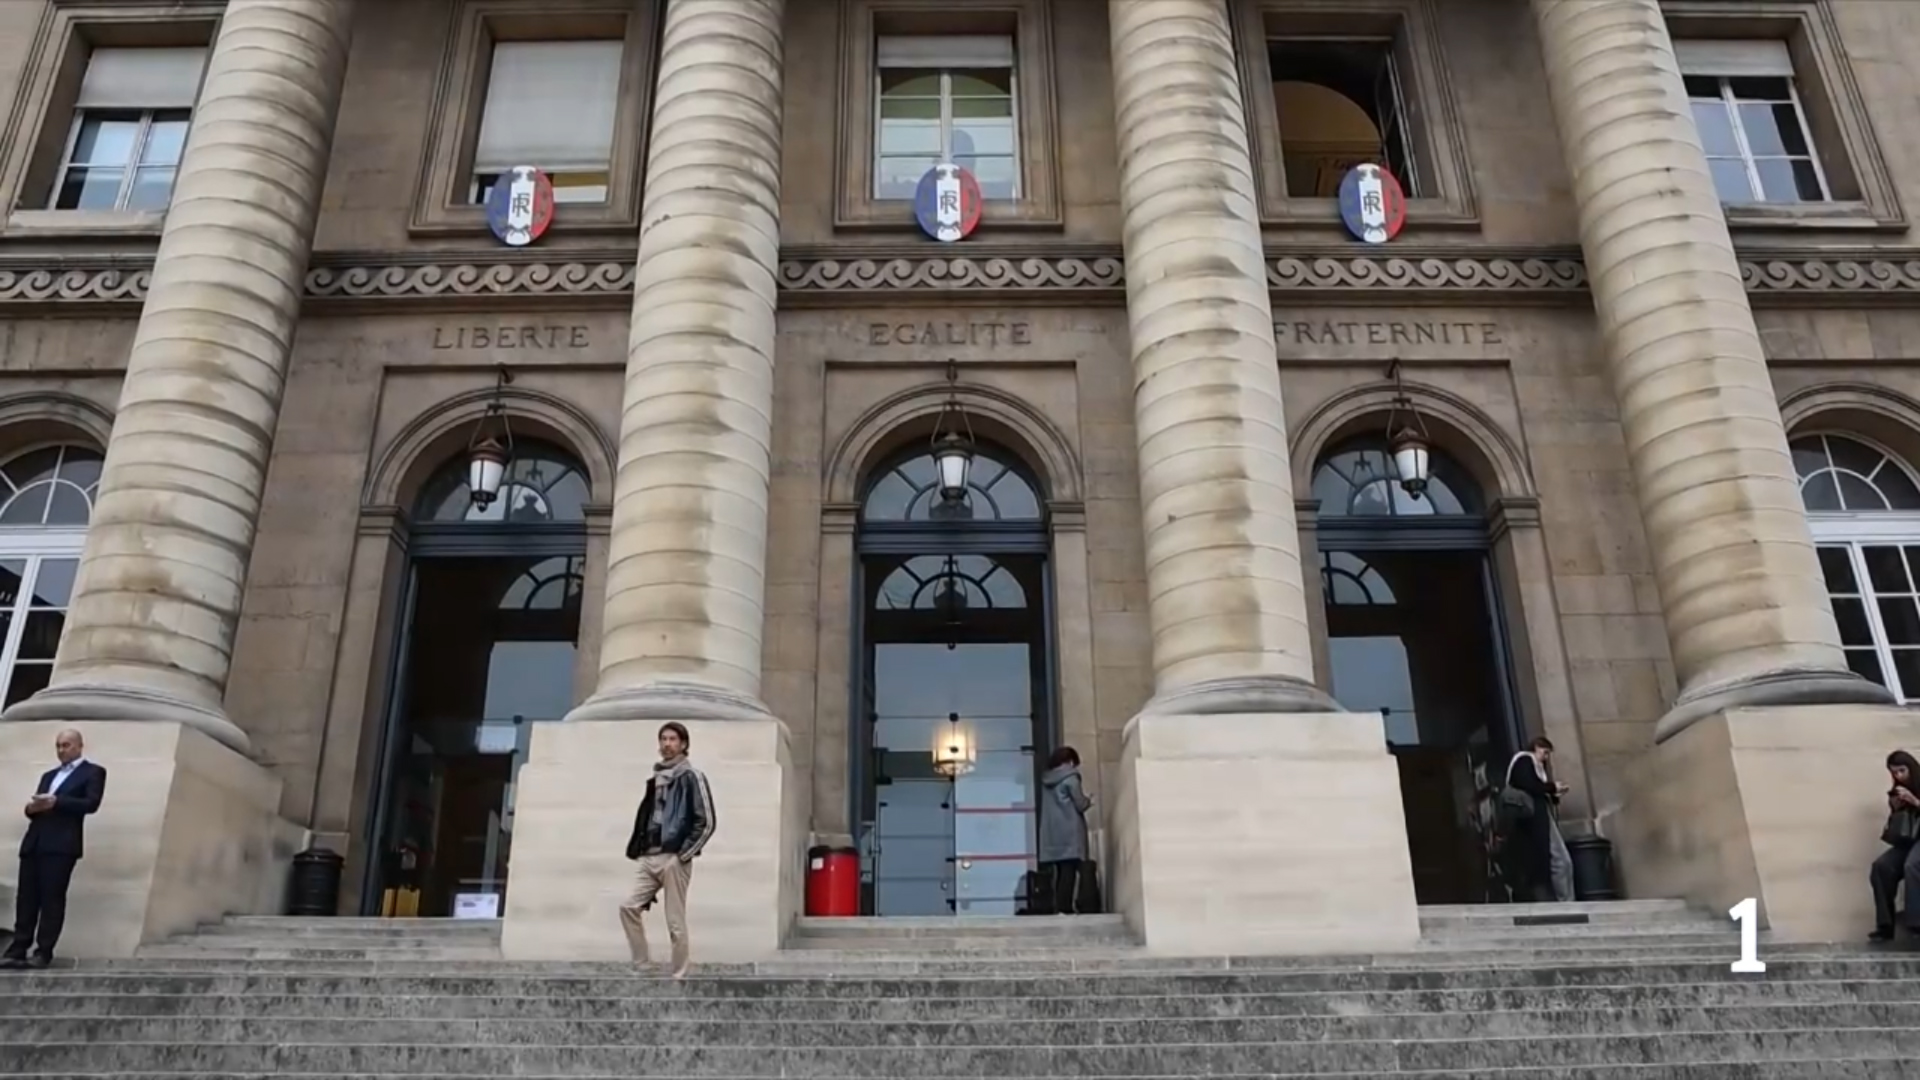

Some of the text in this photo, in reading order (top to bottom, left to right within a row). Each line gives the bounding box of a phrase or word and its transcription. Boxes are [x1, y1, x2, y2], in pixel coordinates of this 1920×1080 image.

[433, 325, 590, 350] LIBERTE
[868, 321, 1032, 347] EGALITE
[1273, 321, 1503, 345] FRATERNITE
